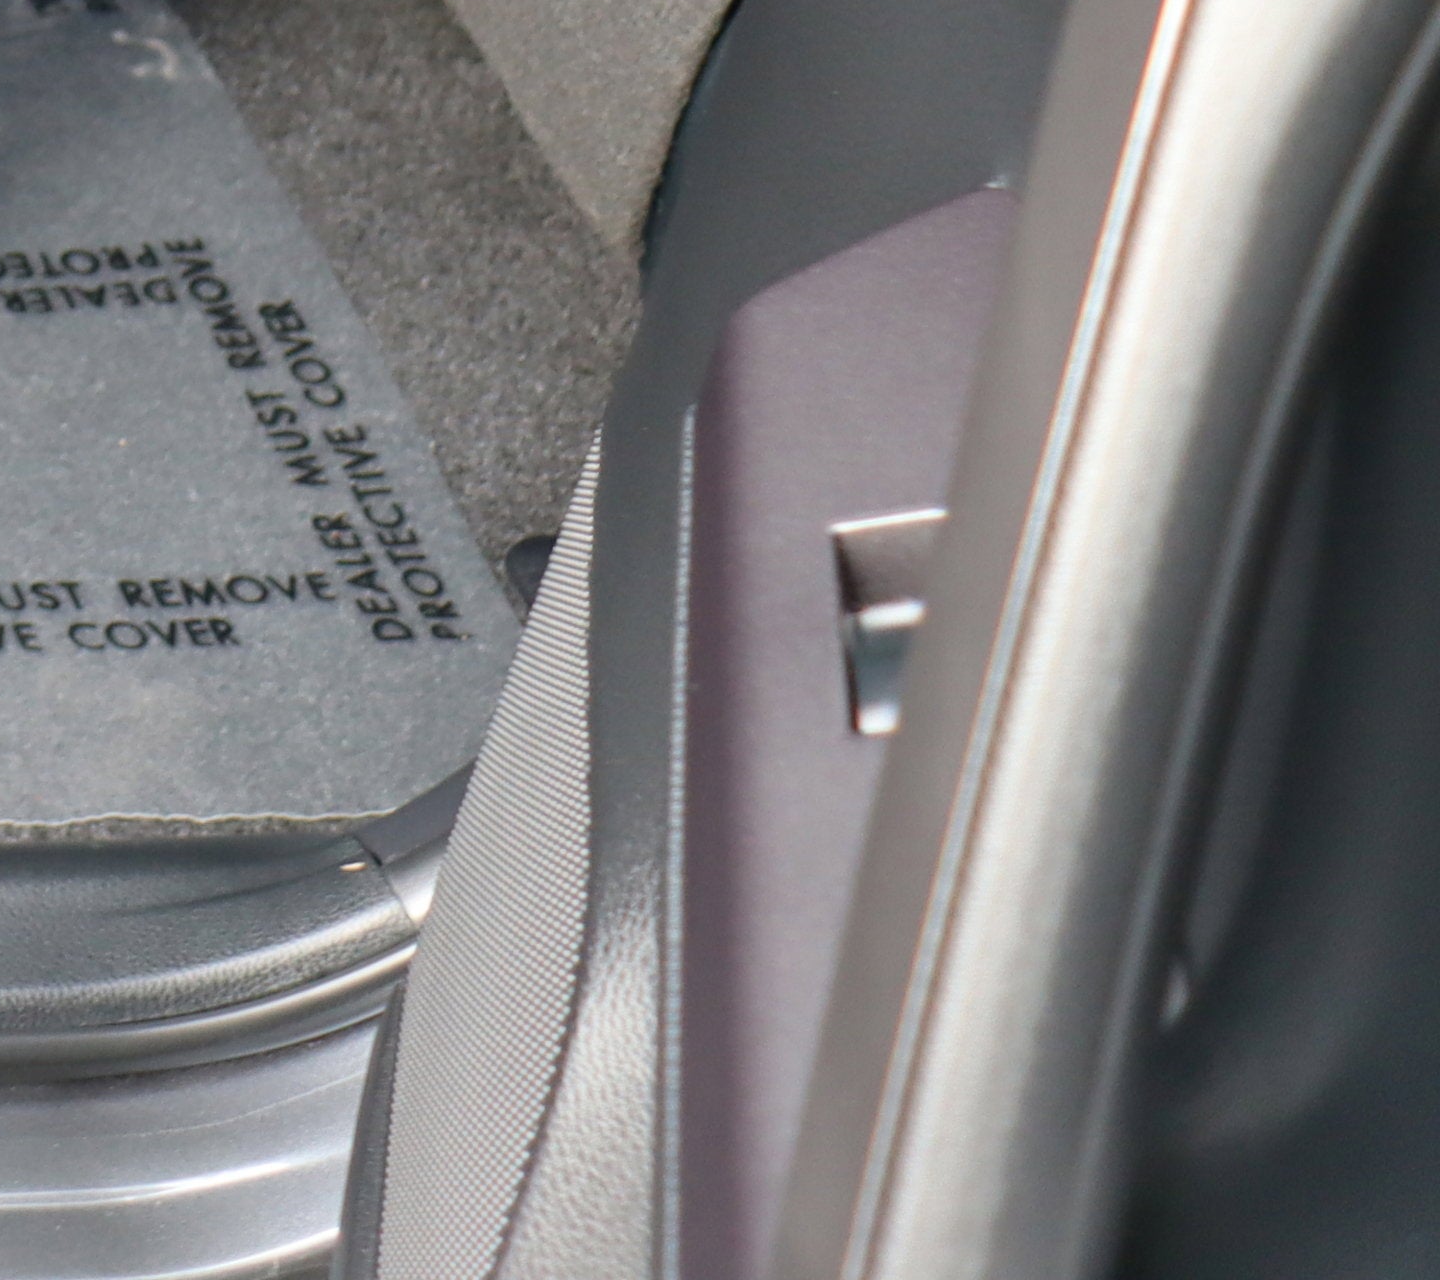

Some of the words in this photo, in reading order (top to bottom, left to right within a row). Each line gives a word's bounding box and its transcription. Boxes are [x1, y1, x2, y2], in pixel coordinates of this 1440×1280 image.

[164, 237, 268, 372] REMOVE
[256, 298, 347, 410] COVER
[245, 386, 331, 489] MUST
[311, 510, 418, 642] DEALER
[322, 423, 473, 641] PROTECTIVE
[66, 614, 242, 651] COVER
[116, 570, 339, 609] REMOVE
